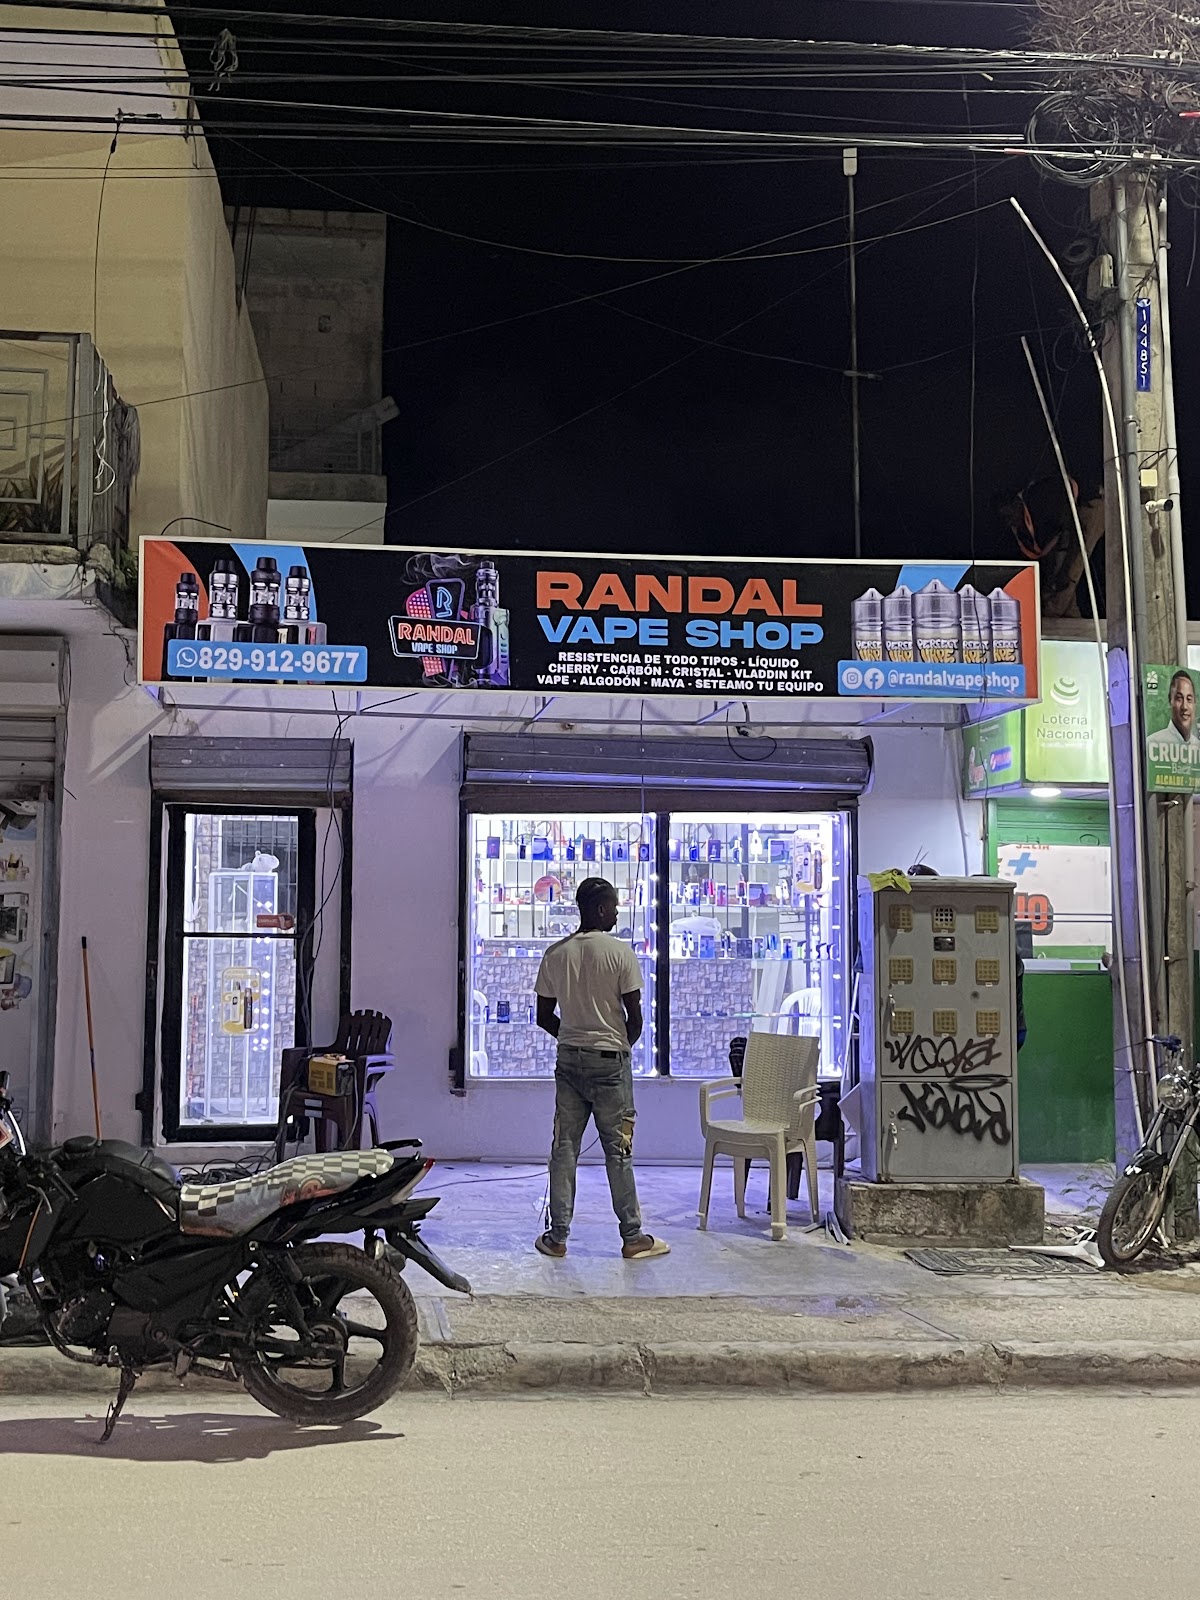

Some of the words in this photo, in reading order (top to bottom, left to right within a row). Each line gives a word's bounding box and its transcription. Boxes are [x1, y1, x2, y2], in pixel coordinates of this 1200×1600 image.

[1140, 309, 1148, 388] 144851
[536, 571, 823, 618] RANDAL
[397, 622, 476, 646] RANDAL
[536, 614, 669, 646] VAPE
[685, 618, 824, 650] SHOP
[411, 641, 434, 654] VAPE
[435, 643, 458, 655] SHOP
[198, 646, 360, 674] 829-912-9677
[558, 651, 641, 664] RESISTENCIA
[644, 654, 661, 664] DE
[663, 655, 698, 665] TODO
[701, 655, 738, 666] TIPOS
[748, 655, 799, 668] LÍQUIDO
[548, 663, 599, 674] CHERRY
[610, 663, 662, 676] CARBÓN
[672, 667, 724, 678] CRISTAL
[734, 669, 788, 680] VLADDIN
[791, 670, 812, 680] KIT
[887, 669, 1020, 691] @randalvapeshop
[537, 674, 570, 685] VAPE
[580, 674, 641, 687] ALGODÓN
[651, 677, 685, 688] MAYA
[695, 679, 754, 690] SETEAMO
[757, 681, 774, 691] TU
[777, 681, 824, 692] EQUIPO
[1036, 727, 1094, 740] Nacional
[1148, 742, 1200, 765] CRUCIT
